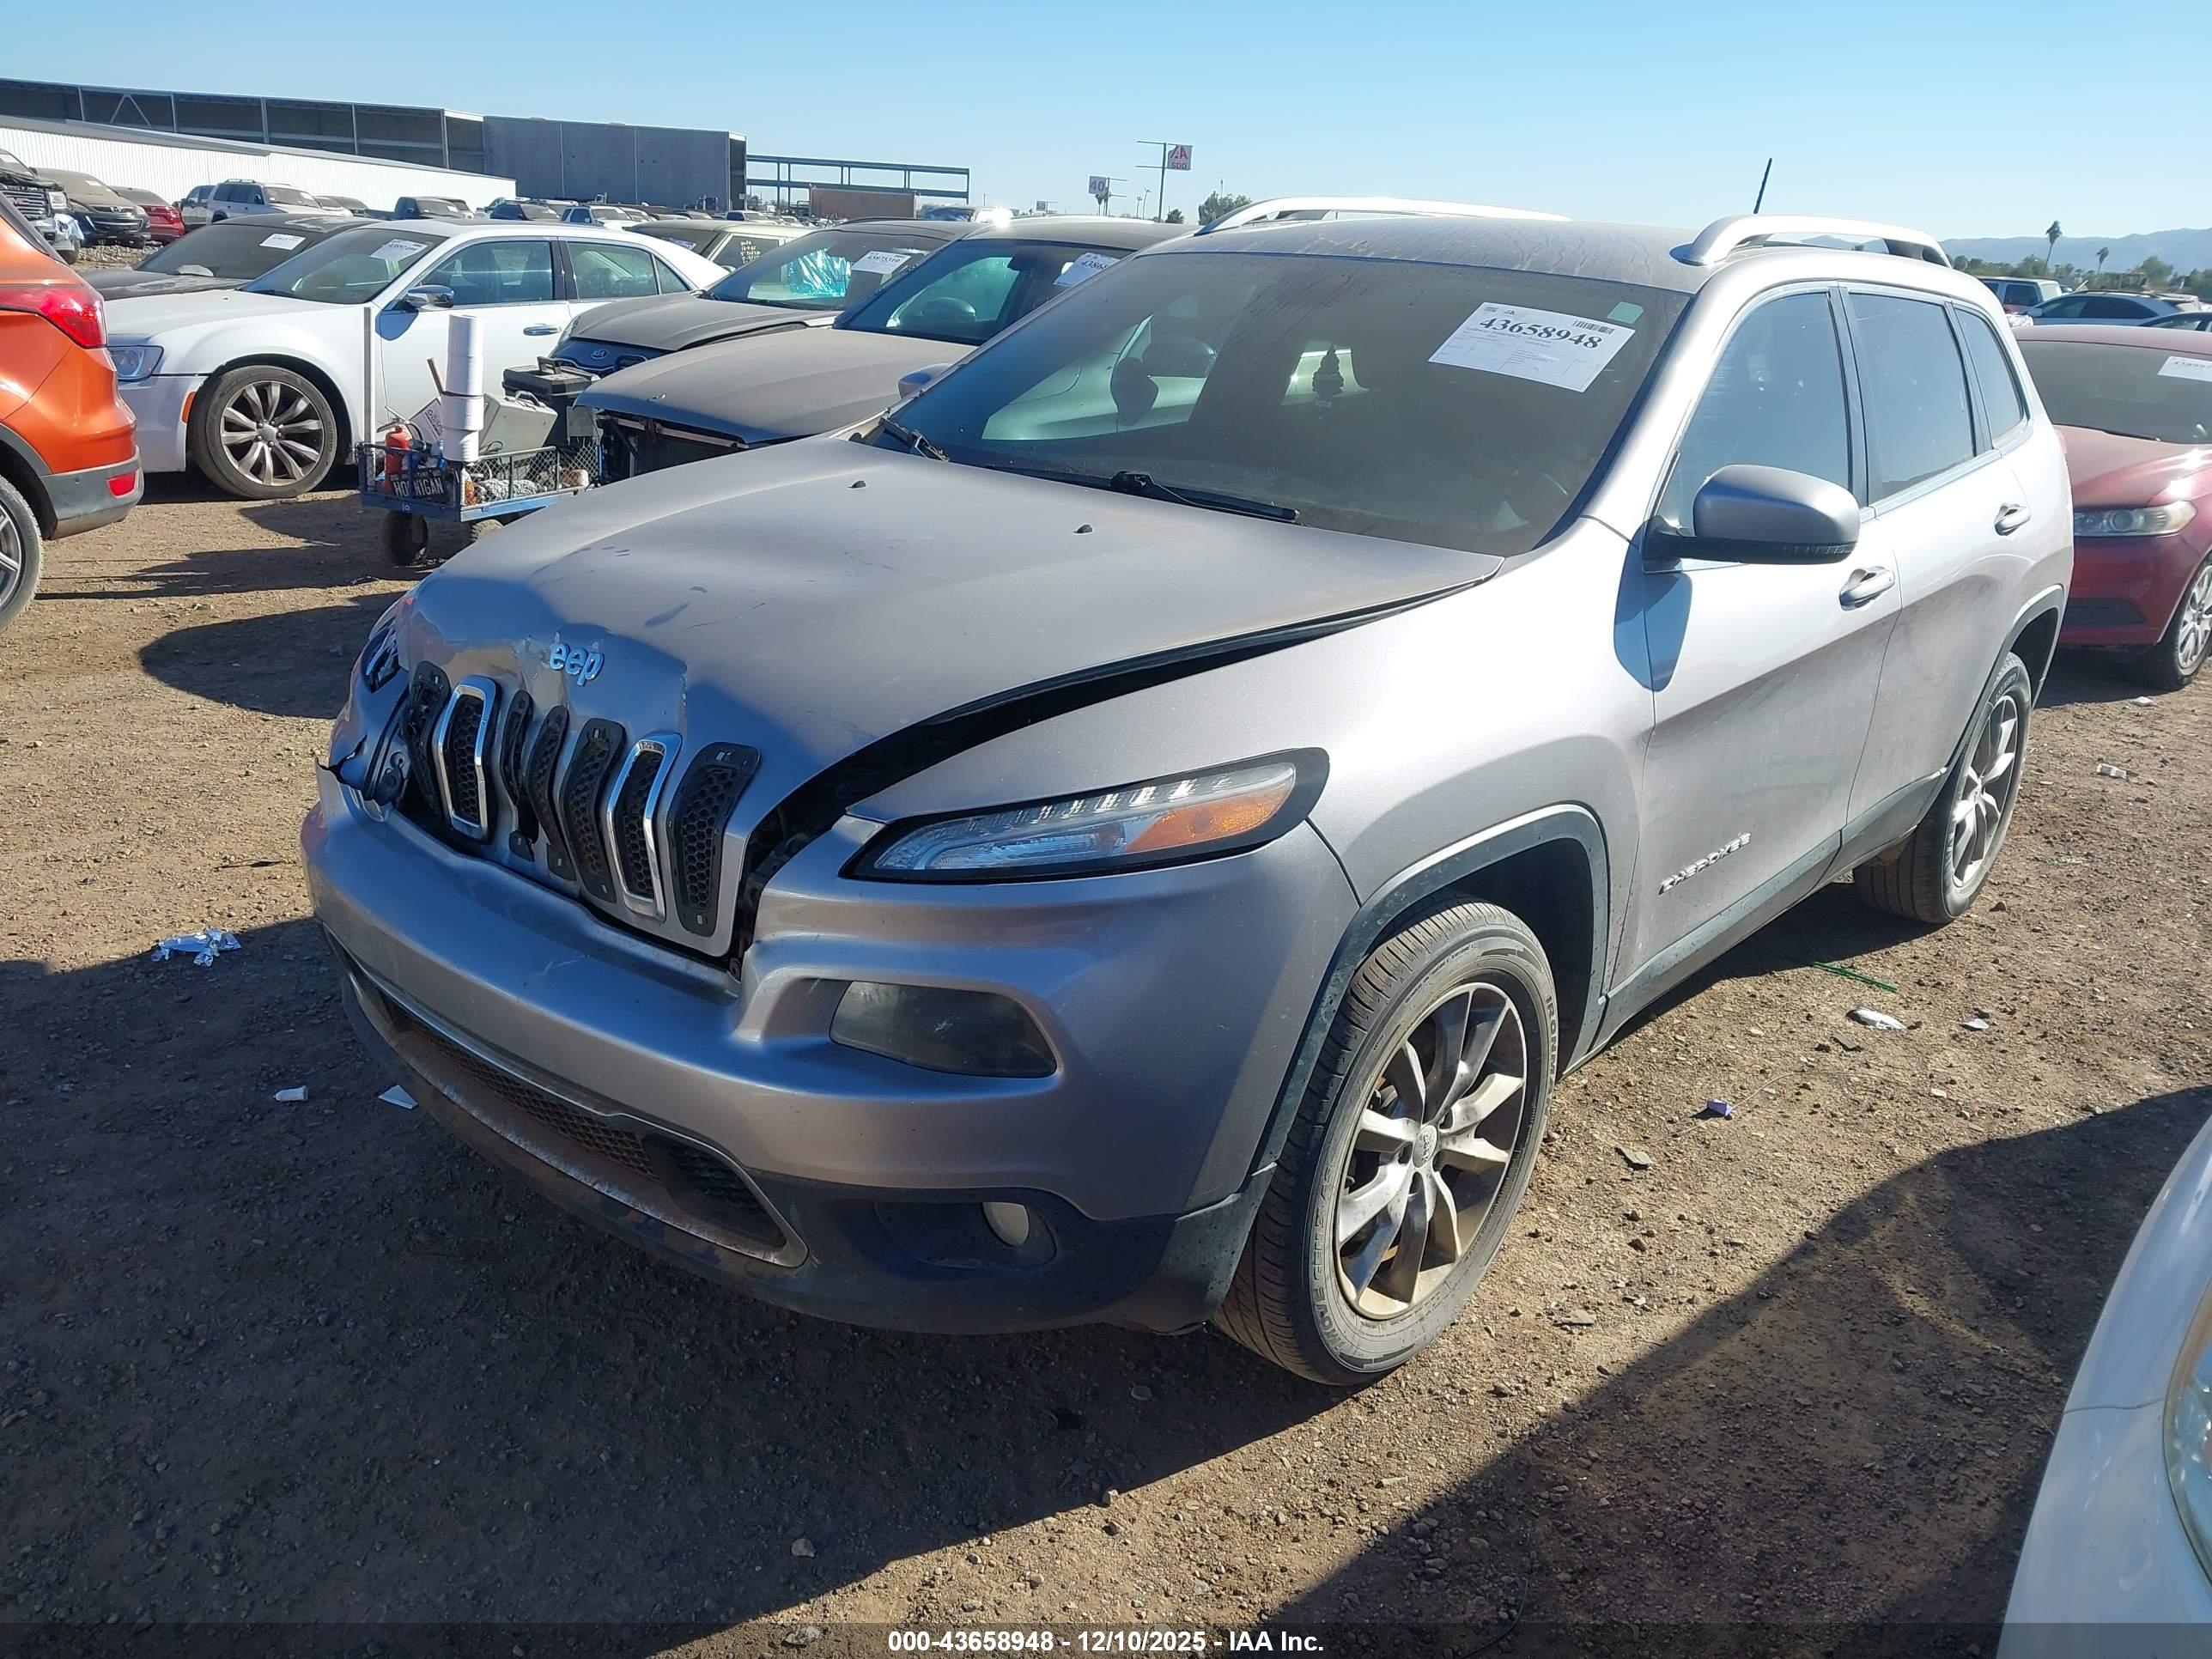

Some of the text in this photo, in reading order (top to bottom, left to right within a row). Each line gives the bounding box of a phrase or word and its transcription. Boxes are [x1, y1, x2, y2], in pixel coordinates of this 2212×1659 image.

[1091, 180, 1105, 191] 40
[1480, 318, 1603, 349] 43658948
[392, 477, 444, 496] HONIGAN
[1657, 832, 1752, 895] CHEROKEE
